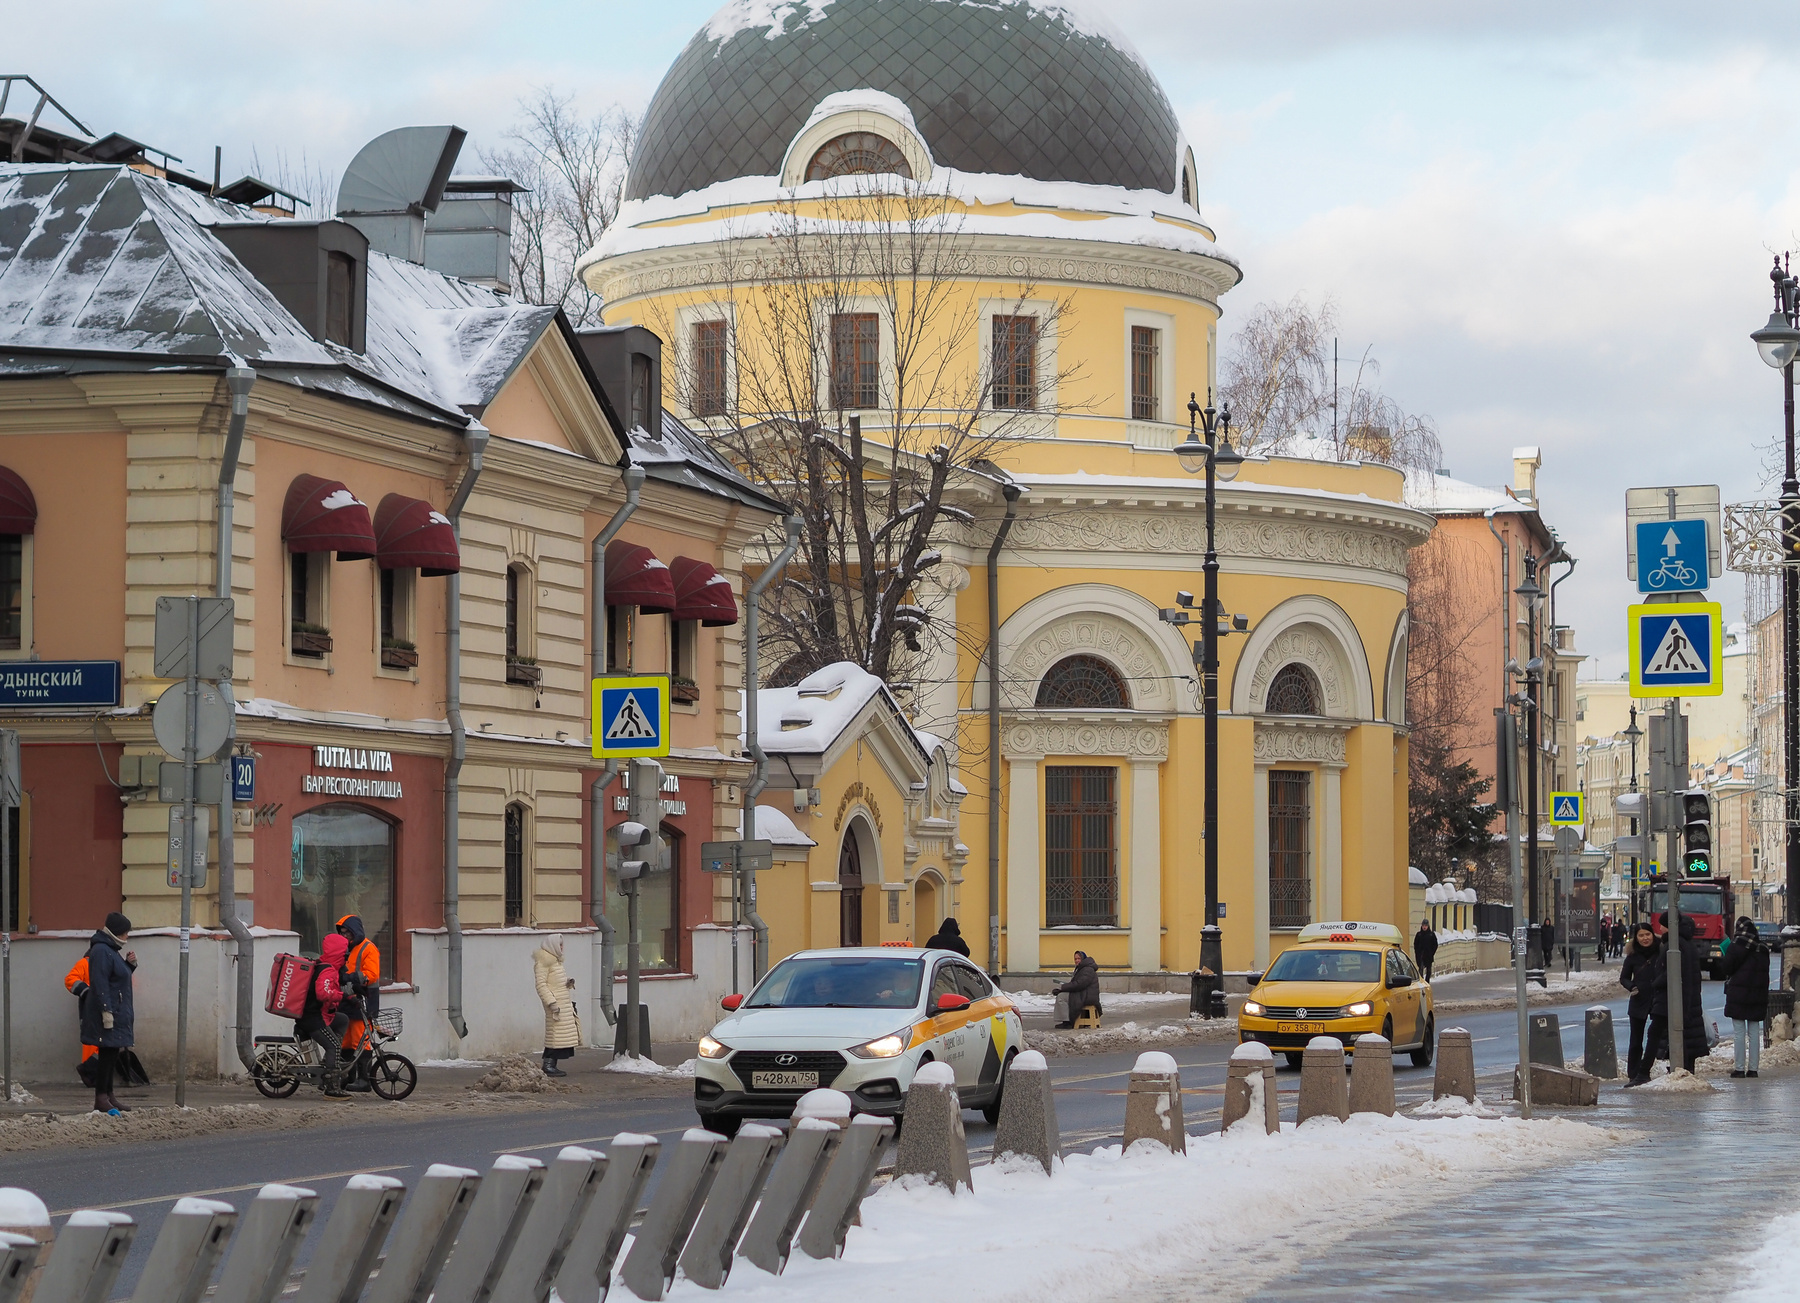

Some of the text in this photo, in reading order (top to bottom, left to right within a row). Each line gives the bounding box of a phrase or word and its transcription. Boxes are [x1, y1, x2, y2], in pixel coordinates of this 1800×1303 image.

[16, 689, 50, 697] ТУПИК
[316, 746, 393, 772] TUTTA LA VITA
[238, 764, 252, 786] 20
[306, 775, 403, 798] БАР РЕСТОРАН ПИЦЦА
[1295, 1024, 1309, 1032] 358
